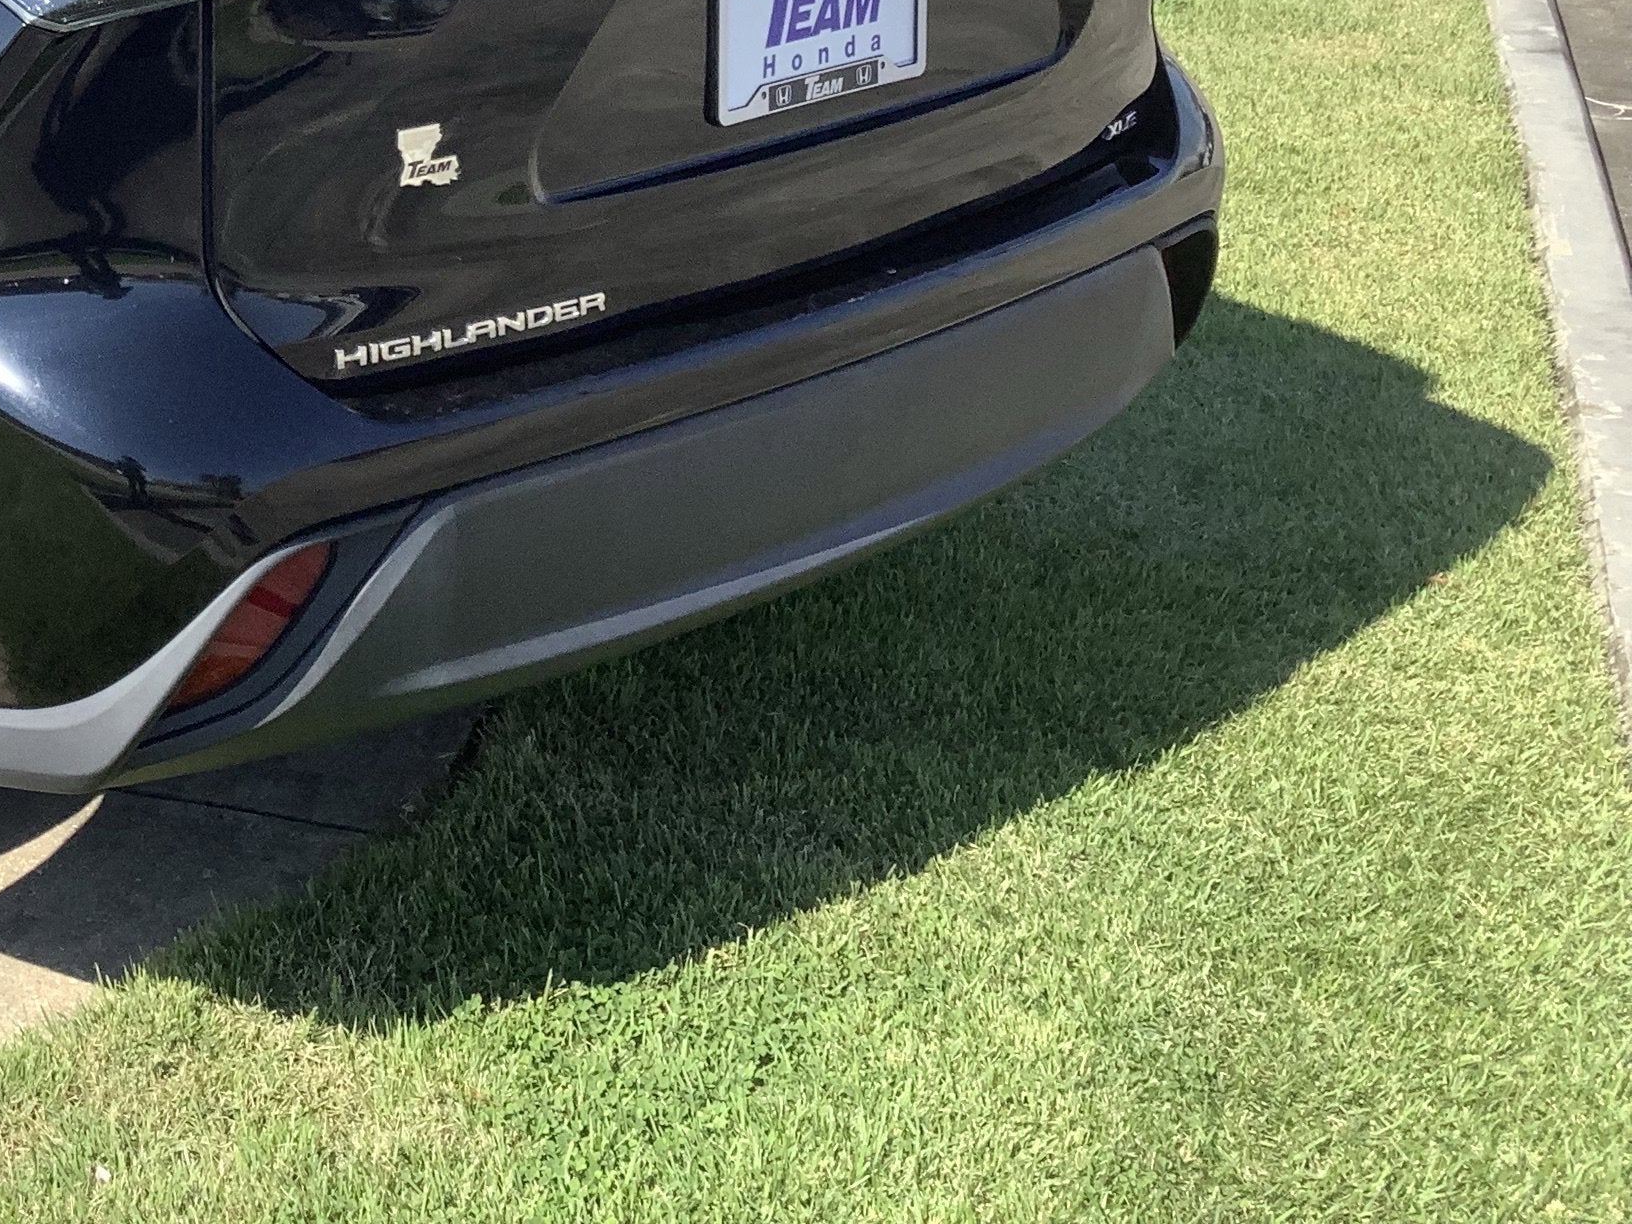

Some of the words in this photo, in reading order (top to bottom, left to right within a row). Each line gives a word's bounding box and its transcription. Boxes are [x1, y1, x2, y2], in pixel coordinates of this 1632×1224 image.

[763, 34, 881, 79] Honda
[804, 74, 845, 101] TEAM
[1101, 110, 1138, 141] XLE
[407, 159, 453, 180] TEAM
[334, 291, 608, 371] HIGHLANDER
